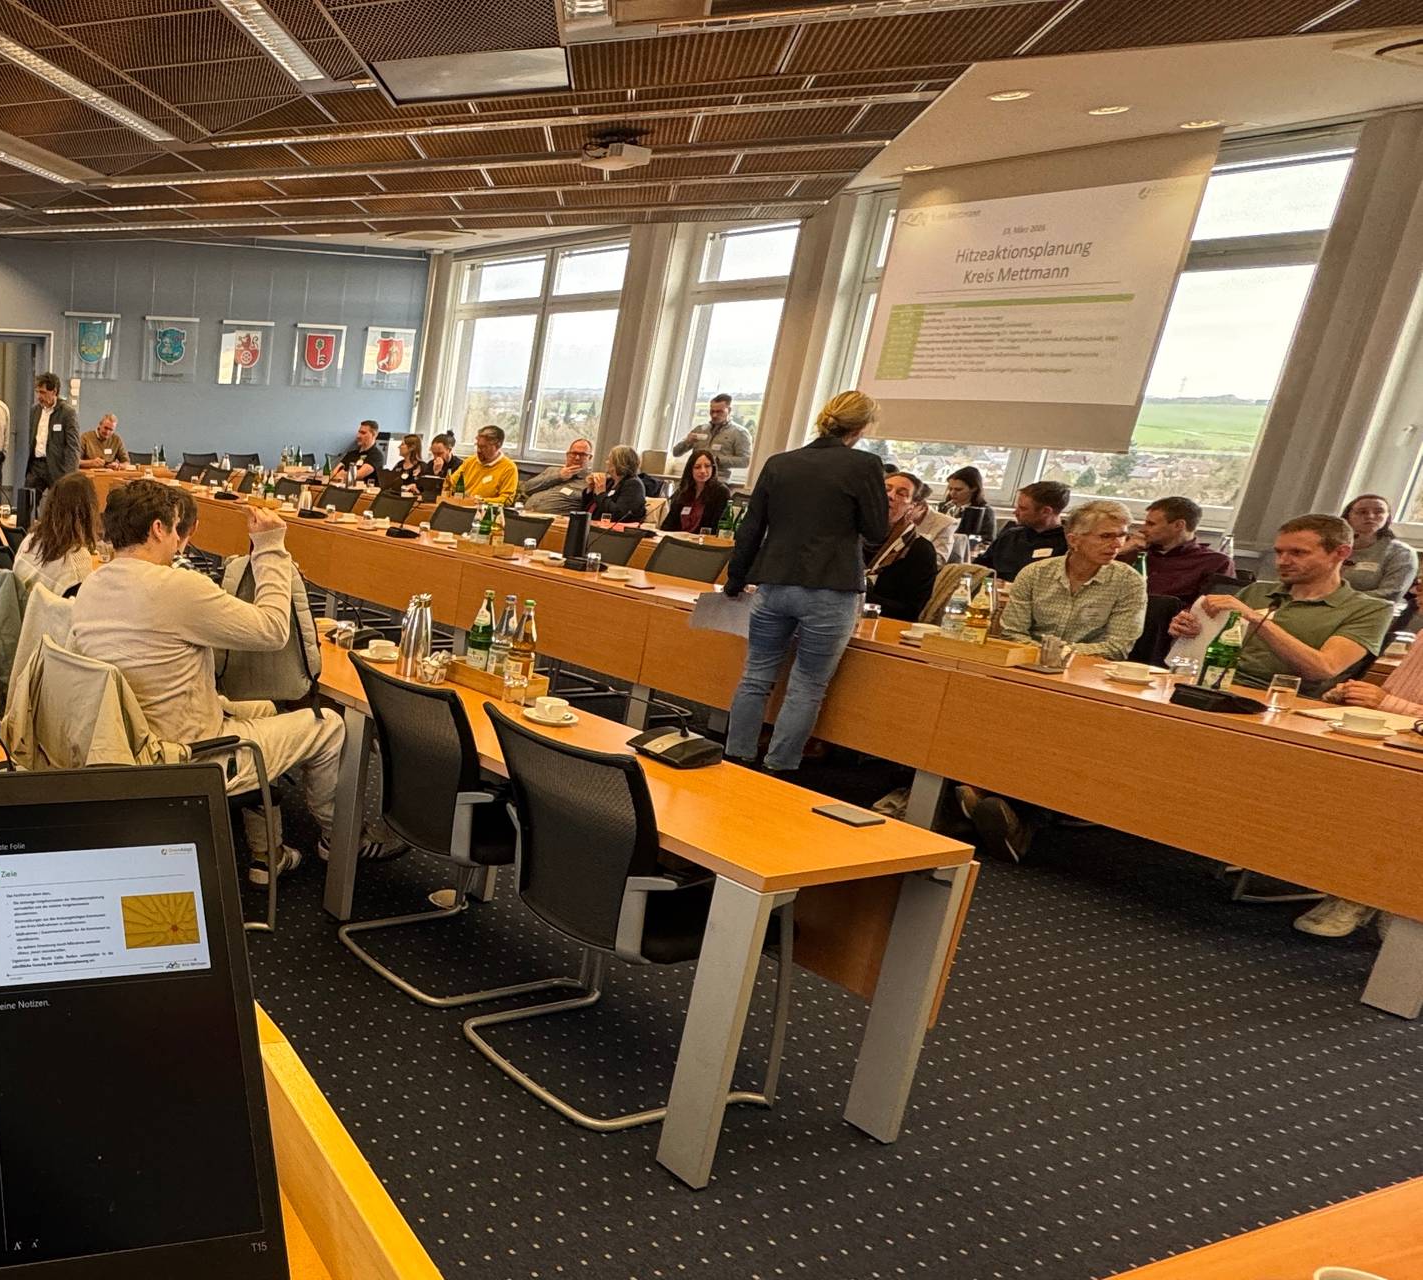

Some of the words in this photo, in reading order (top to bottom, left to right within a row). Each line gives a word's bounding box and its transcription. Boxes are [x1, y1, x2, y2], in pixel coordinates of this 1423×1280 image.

[955, 240, 1092, 264] Hitzeaktionsplanung
[963, 270, 994, 284] Kreis
[997, 265, 1069, 282] Mettmann
[9, 842, 25, 850] Folie
[251, 1242, 267, 1252] T15
